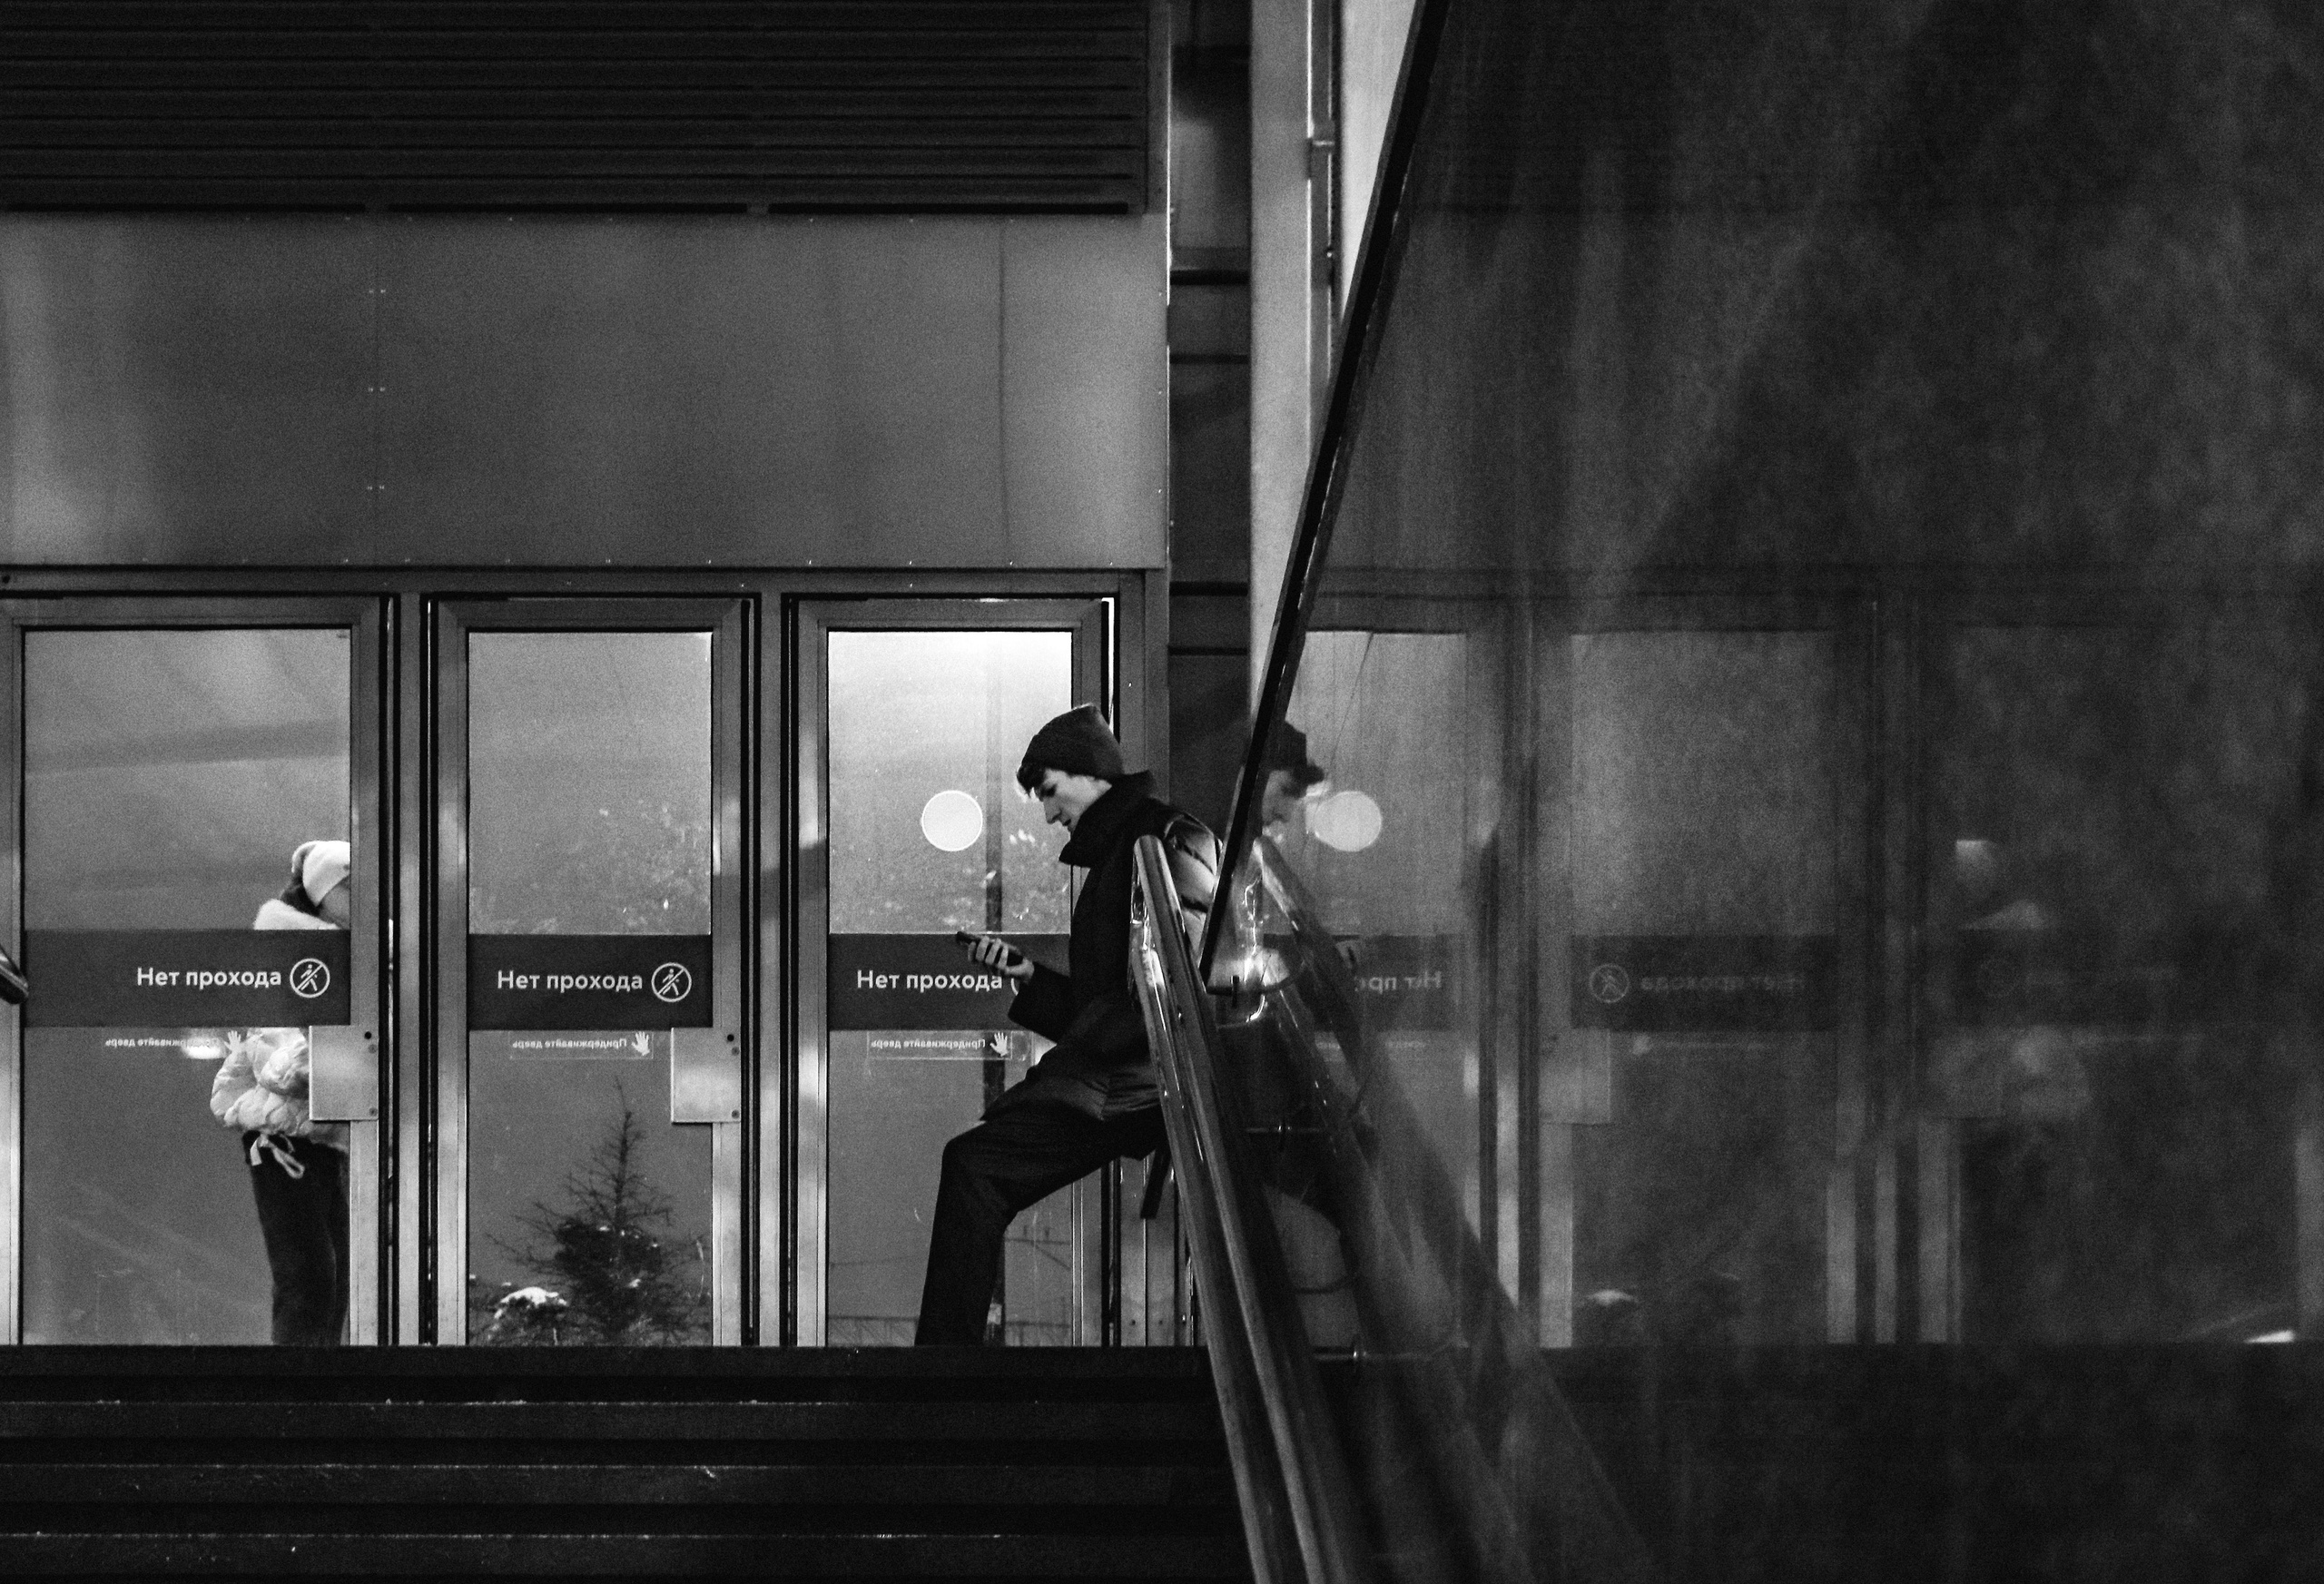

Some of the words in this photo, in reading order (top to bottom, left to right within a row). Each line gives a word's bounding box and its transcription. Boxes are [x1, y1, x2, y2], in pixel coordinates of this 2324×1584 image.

[137, 967, 180, 987] Нет
[185, 970, 282, 989] прохода
[497, 969, 541, 989] Нет
[547, 974, 643, 993] прохода
[856, 969, 900, 989] Нет
[906, 974, 1003, 993] прохода
